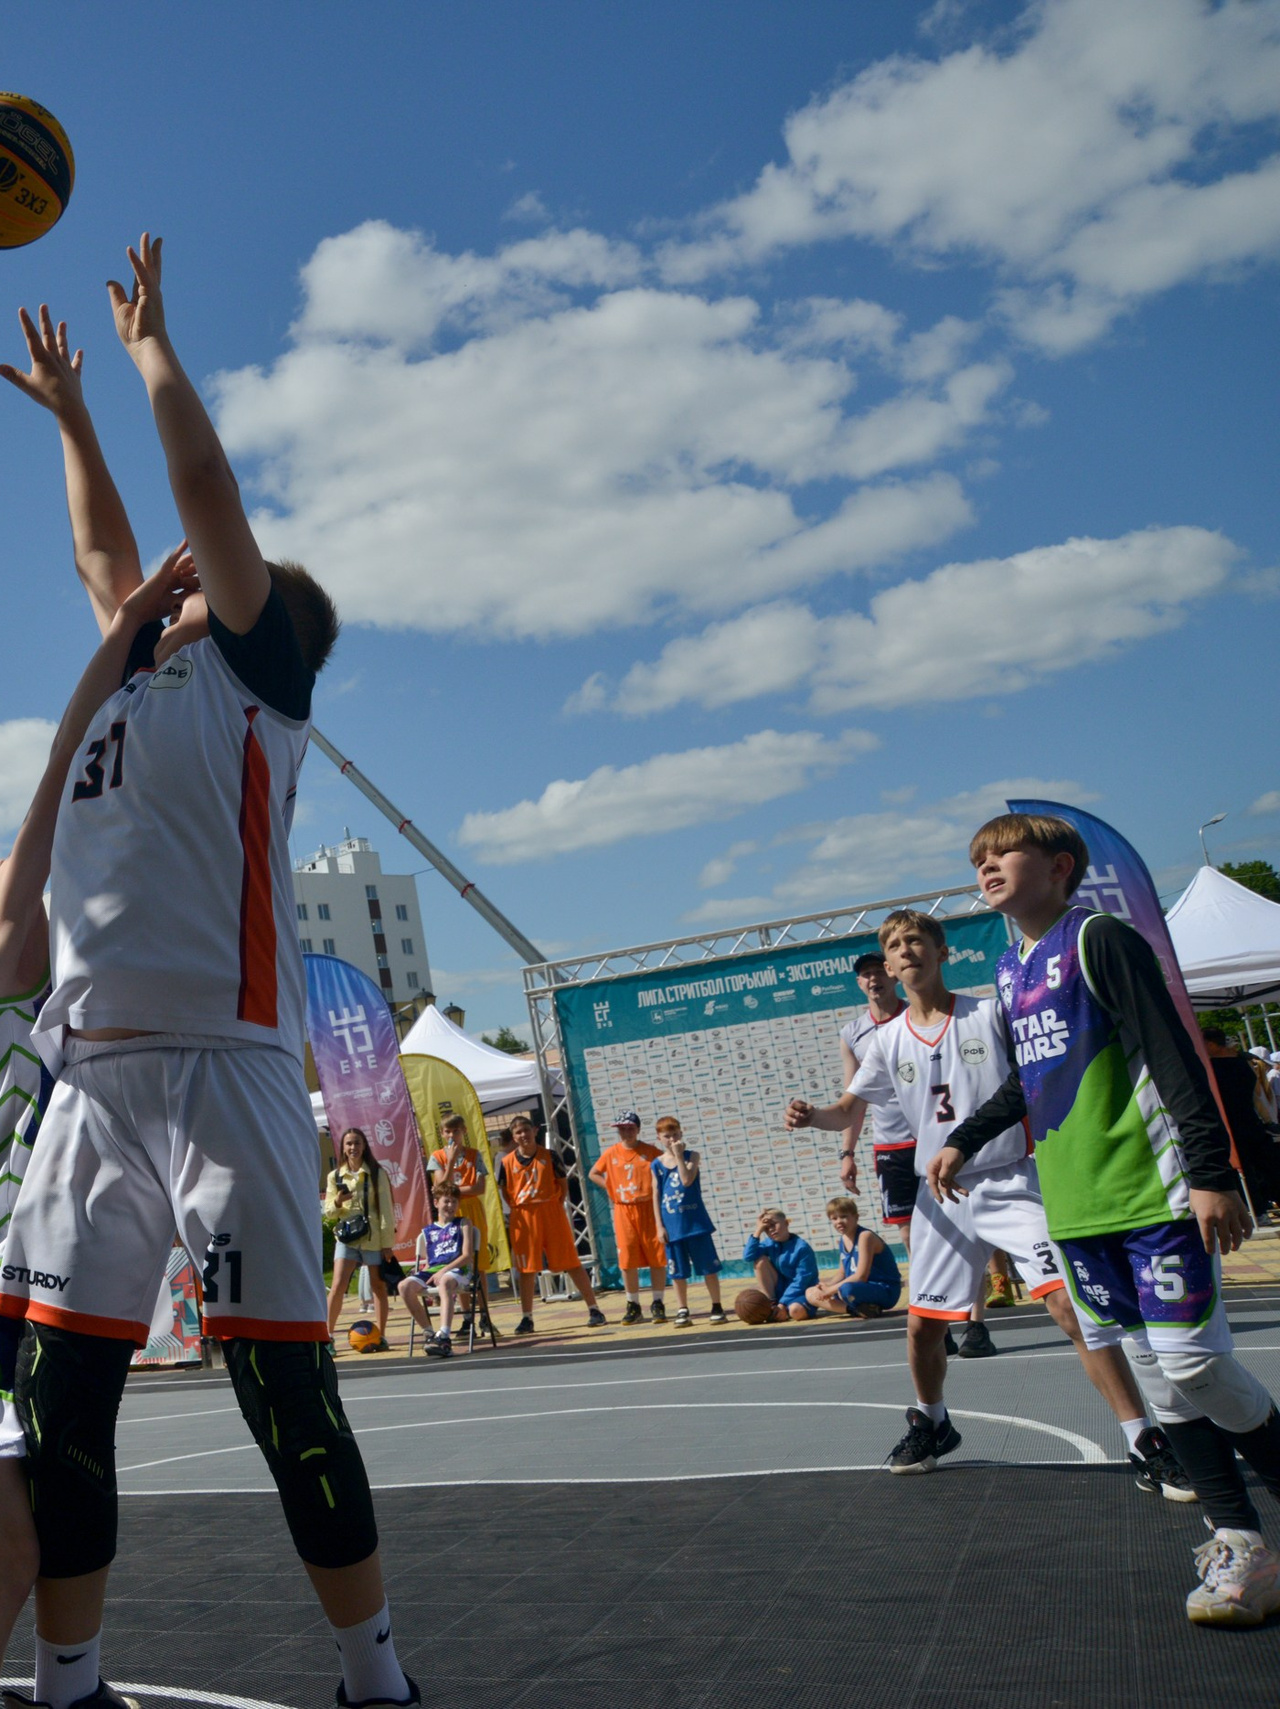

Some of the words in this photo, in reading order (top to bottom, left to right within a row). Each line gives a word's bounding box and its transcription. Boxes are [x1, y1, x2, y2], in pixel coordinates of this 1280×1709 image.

[72, 721, 126, 803] 31
[1046, 953, 1061, 989] 5
[637, 988, 667, 1008] ЛИГА
[665, 977, 725, 1003] СТРИТБОЛ
[724, 965, 778, 994] ГОРЬКИЙ
[963, 1047, 986, 1056] РФБ
[931, 1083, 956, 1123] 3
[624, 1164, 634, 1180] 7
[1032, 1241, 1049, 1250] GS
[1036, 1250, 1059, 1275] 3
[2, 1264, 70, 1292] STURDY
[1150, 1254, 1186, 1302] 5
[917, 1293, 948, 1303] STURDY
